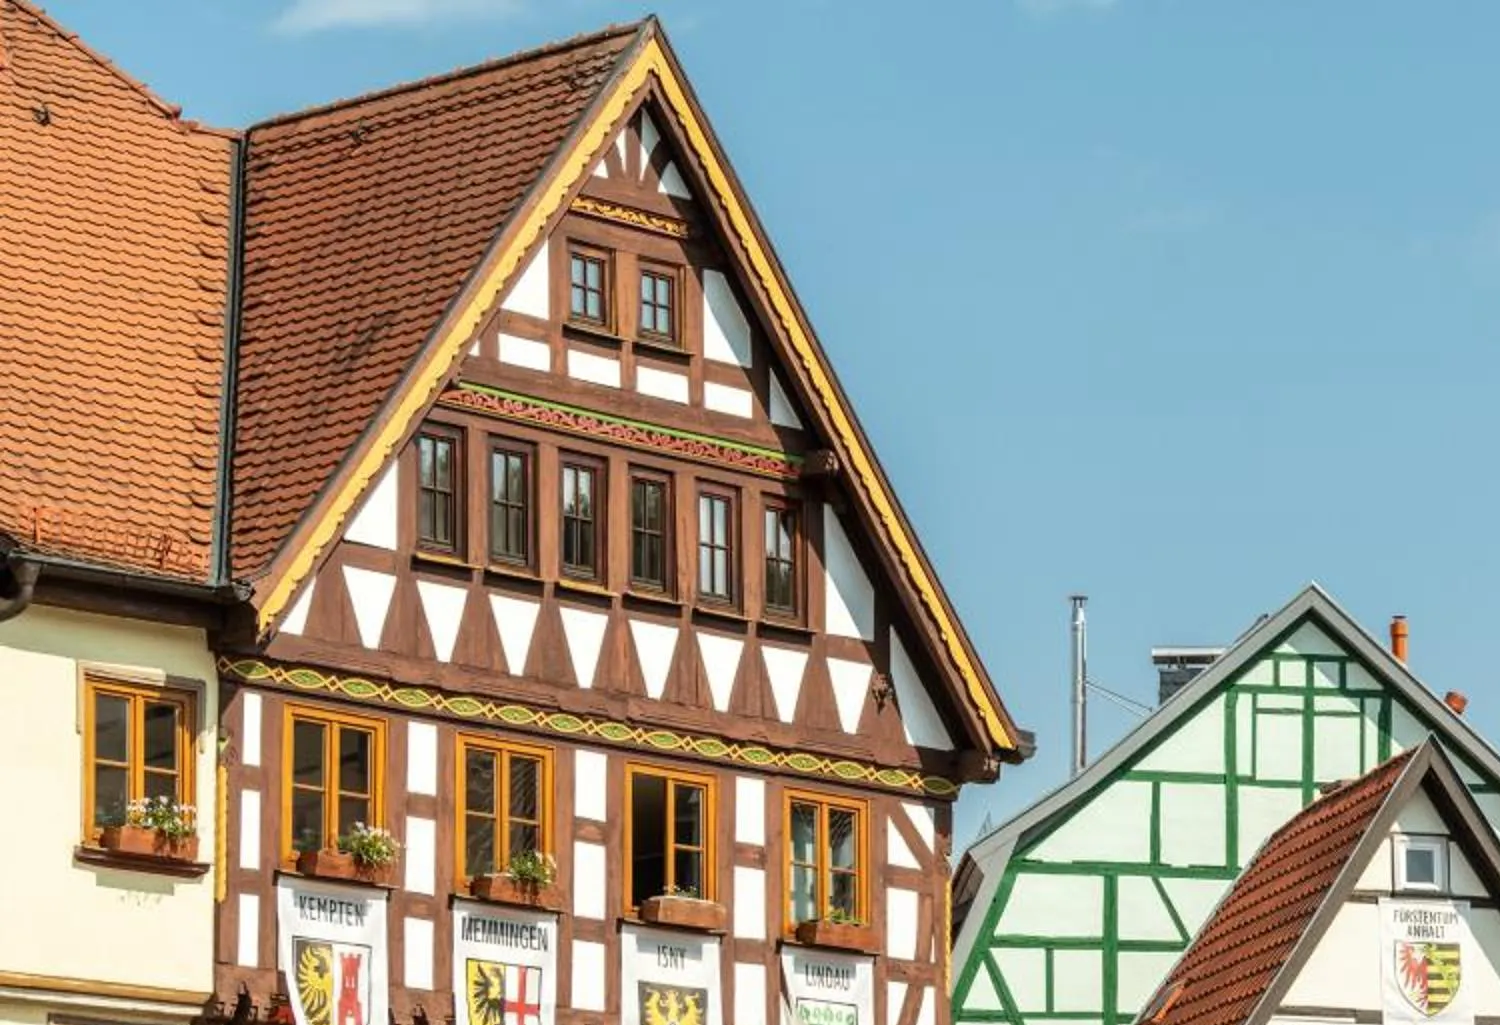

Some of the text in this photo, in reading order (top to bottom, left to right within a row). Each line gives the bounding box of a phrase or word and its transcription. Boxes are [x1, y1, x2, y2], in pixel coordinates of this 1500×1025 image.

[298, 895, 364, 927] KEMPTEN
[461, 916, 549, 952] MEMMINGEN
[1407, 925, 1445, 938] ANHALT
[657, 945, 686, 970] ISNY
[805, 964, 850, 992] LINDAU
